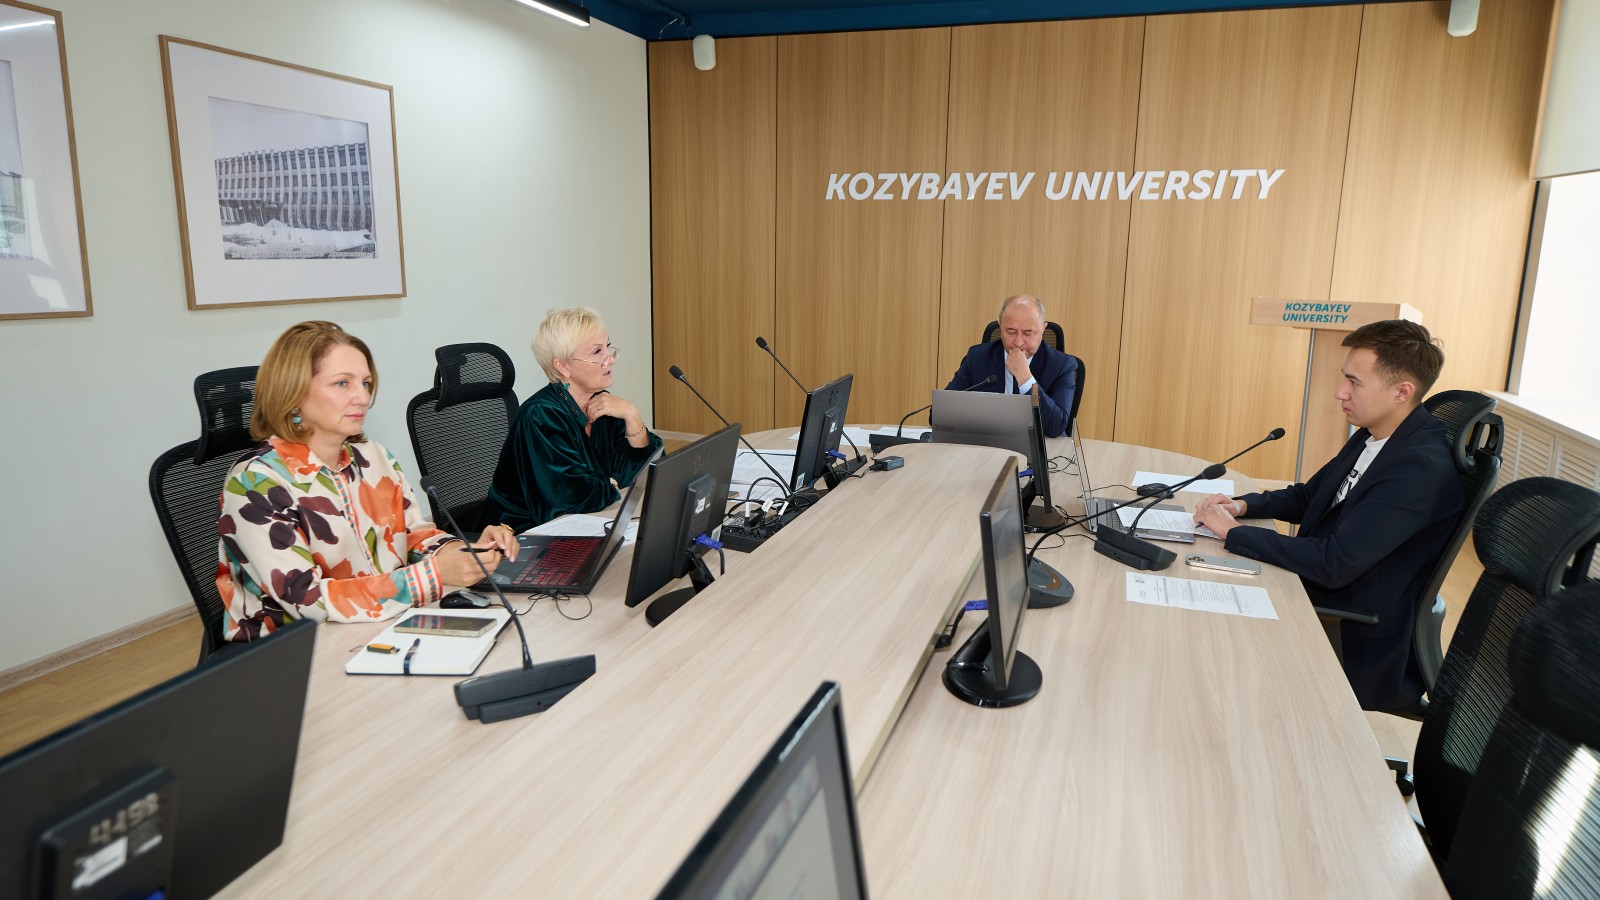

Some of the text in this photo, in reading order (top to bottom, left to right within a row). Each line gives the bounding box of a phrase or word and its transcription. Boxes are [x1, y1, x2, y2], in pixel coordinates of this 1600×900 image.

[825, 168, 1285, 201] KOZYBAYEV UNIVERSITY
[1285, 303, 1351, 313] KOZYBAYEV
[1282, 313, 1349, 324] UNIVERSITY
